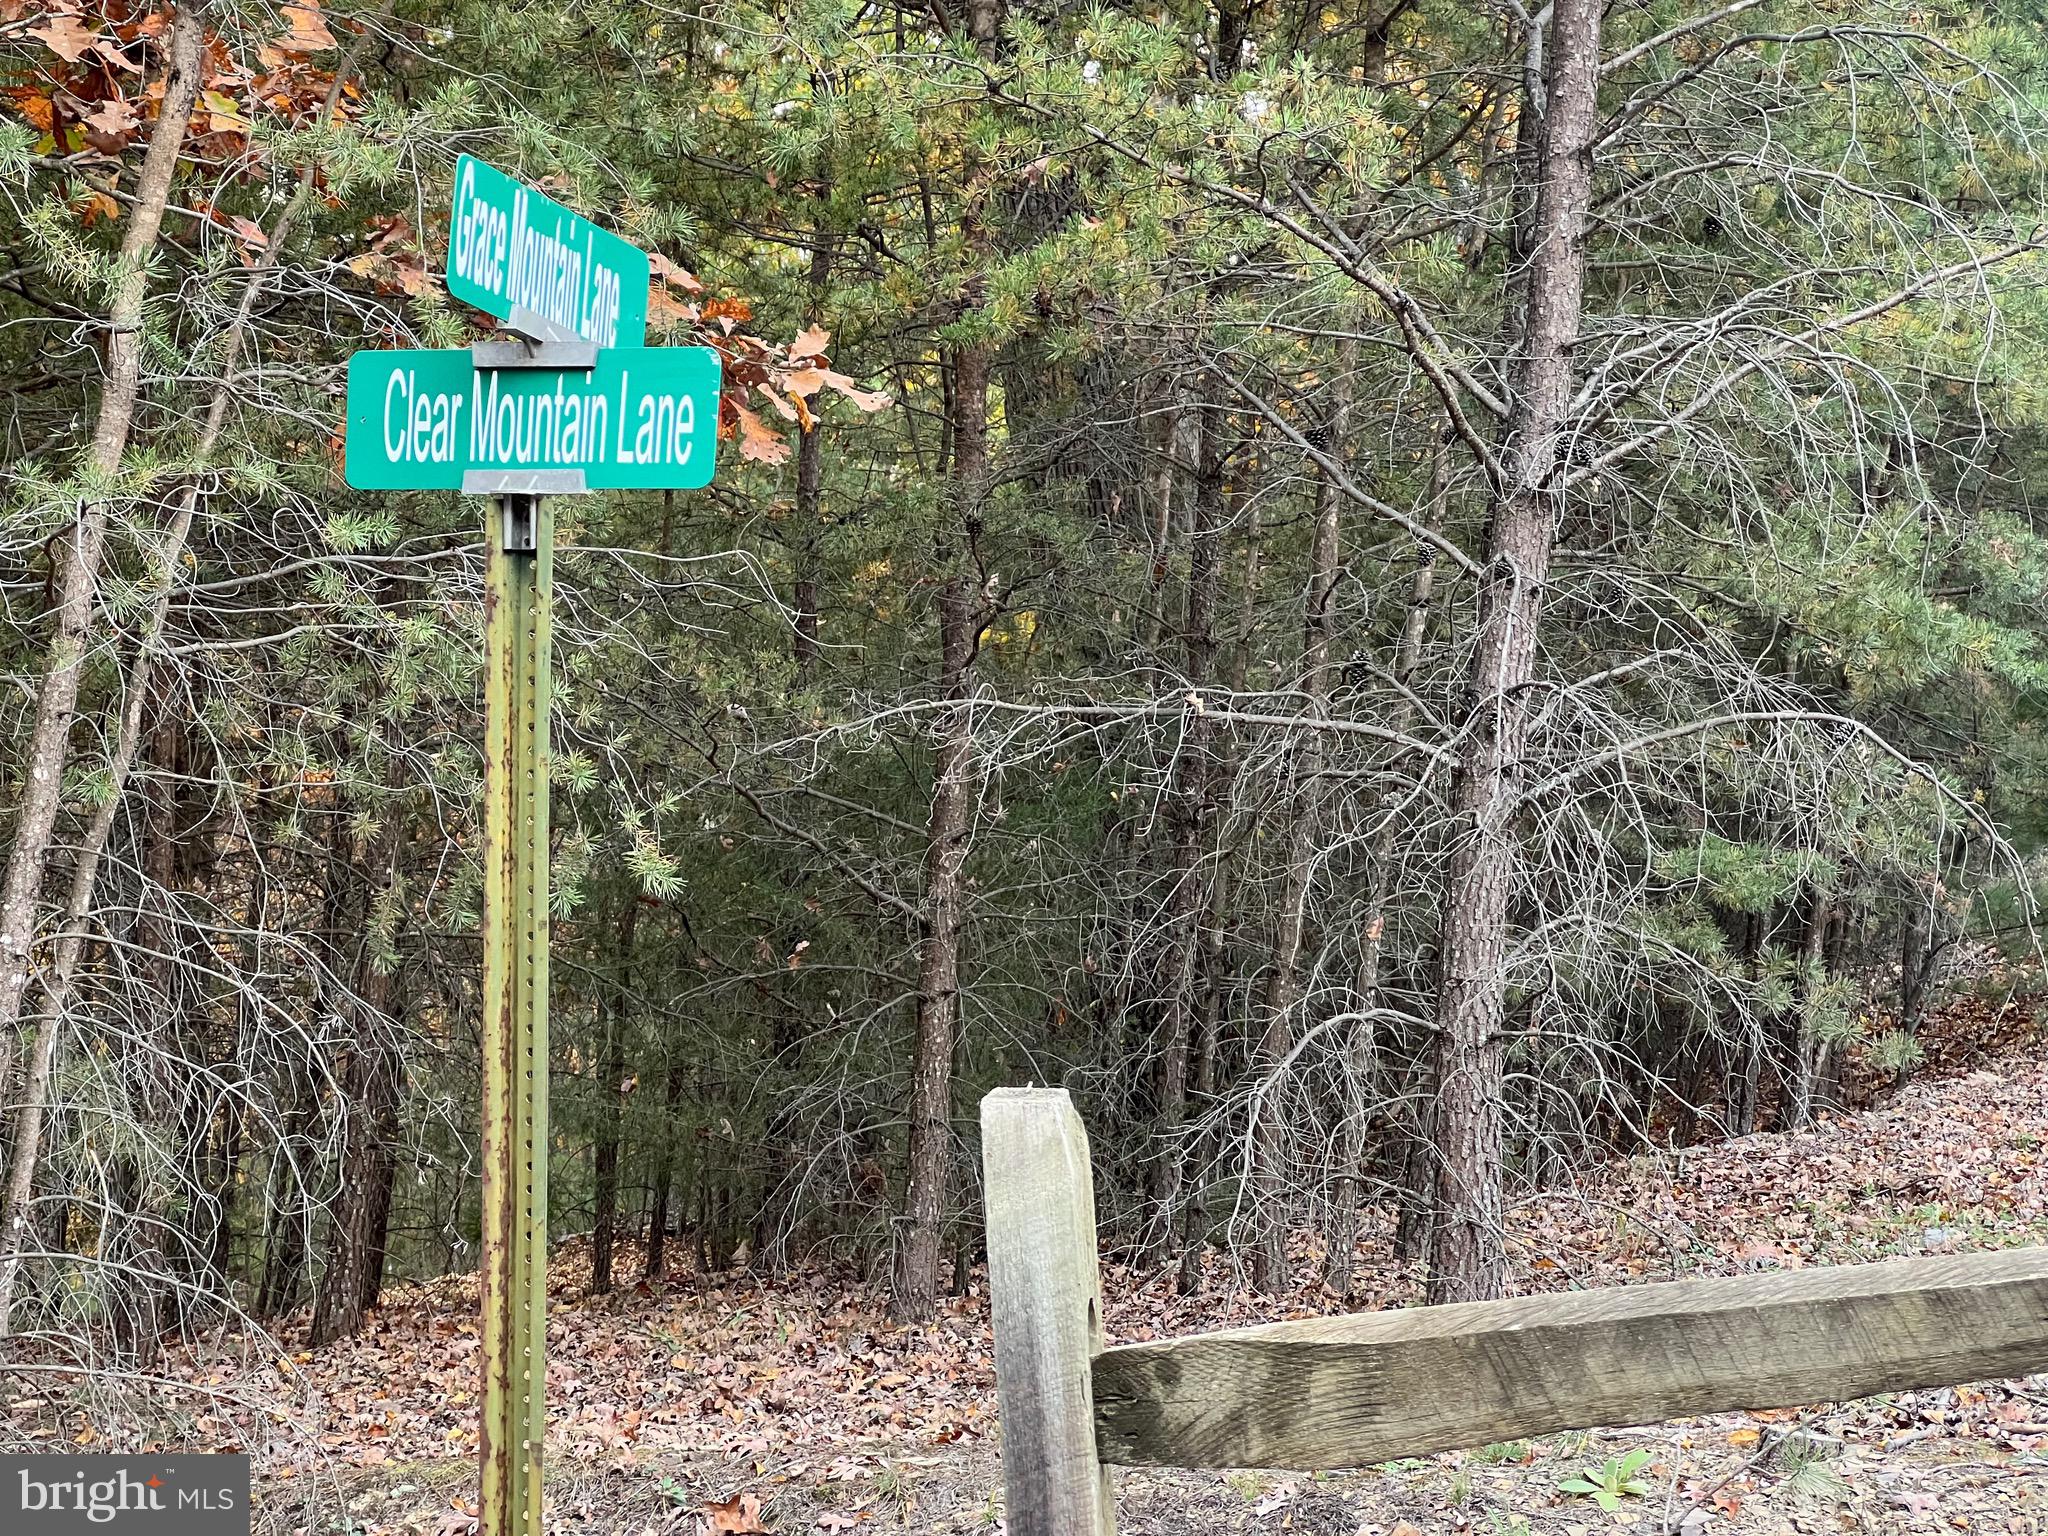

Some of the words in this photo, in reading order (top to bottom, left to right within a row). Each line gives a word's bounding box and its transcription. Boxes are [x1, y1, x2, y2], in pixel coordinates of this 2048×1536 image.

[455, 160, 507, 296] Grace
[506, 188, 582, 334] Mountain
[580, 230, 621, 349] Lane
[383, 367, 463, 463] Clear
[469, 369, 608, 464] Mountain
[616, 370, 695, 465] Lane
